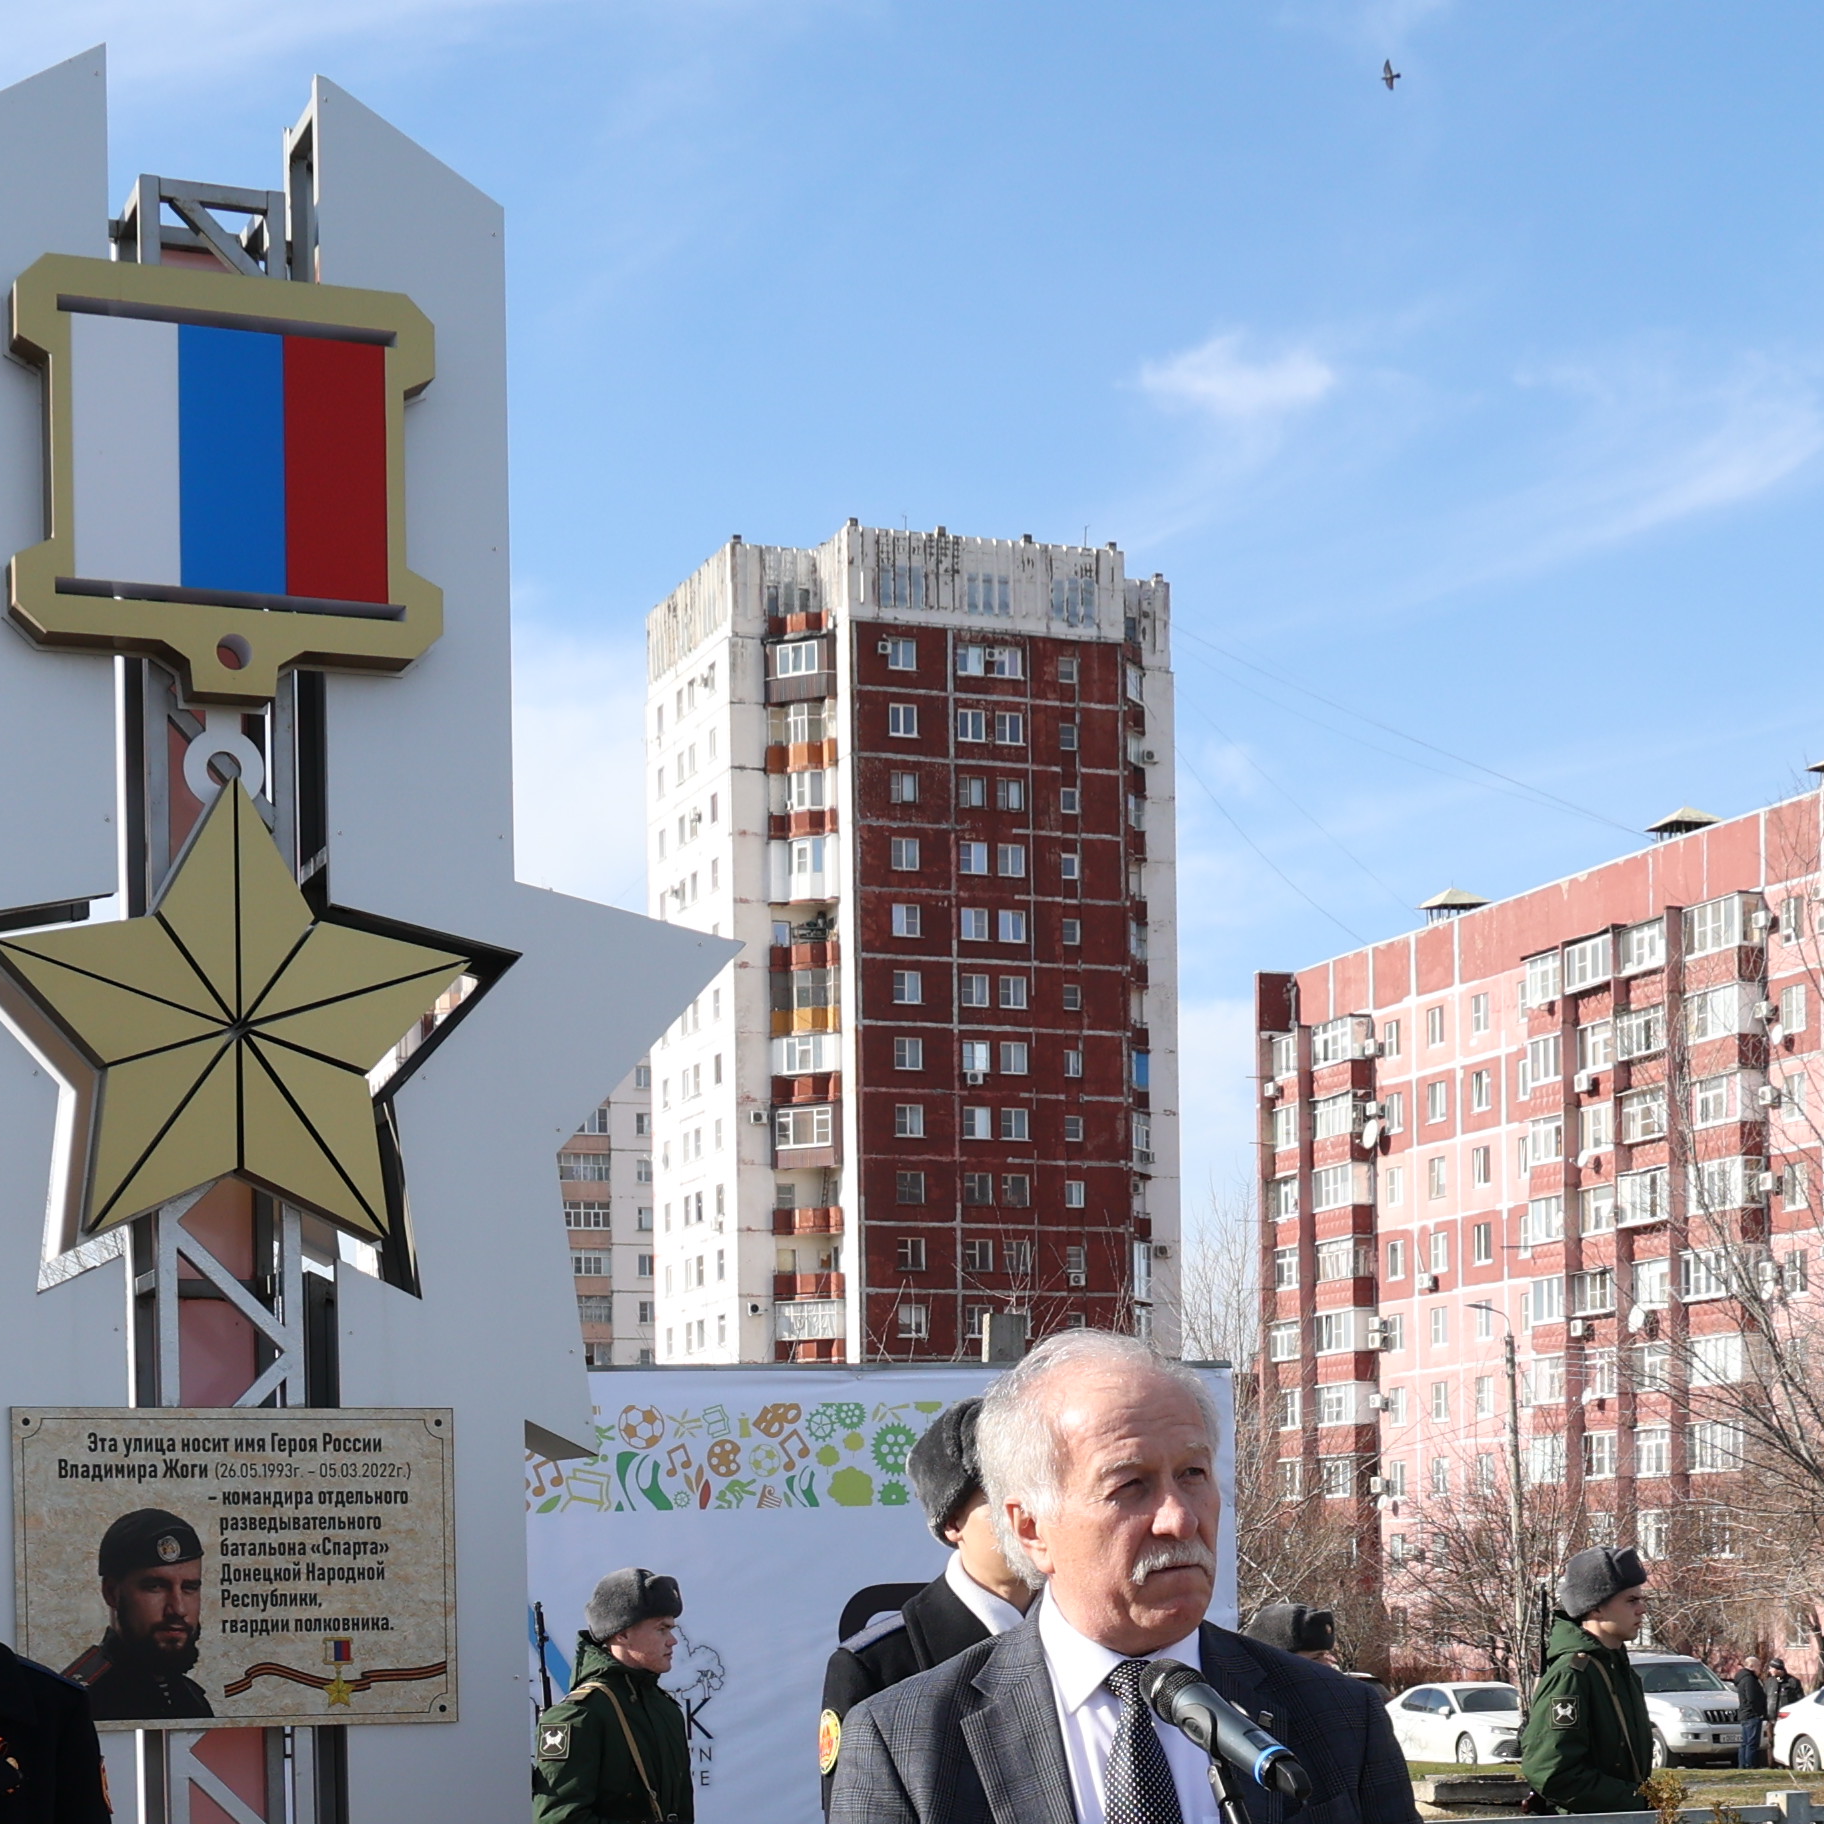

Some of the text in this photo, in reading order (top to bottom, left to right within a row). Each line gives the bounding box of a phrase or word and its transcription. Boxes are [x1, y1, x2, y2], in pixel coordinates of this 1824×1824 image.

[87, 1432, 383, 1458] Эта улица носит имя Героя России
[57, 1458, 158, 1484] Владимира
[162, 1458, 209, 1480] Жоги
[214, 1461, 304, 1480] (26.05.1993г.
[319, 1461, 412, 1481] 05.03.2022г.)
[221, 1490, 314, 1510] командира
[317, 1489, 409, 1508] отдельного
[219, 1515, 382, 1536] разведывательного
[219, 1536, 390, 1560] батальона «Спарта»
[220, 1560, 386, 1586] Донецкой Народной
[221, 1588, 323, 1612] Республики,
[221, 1616, 395, 1638] гвардии полковника.
